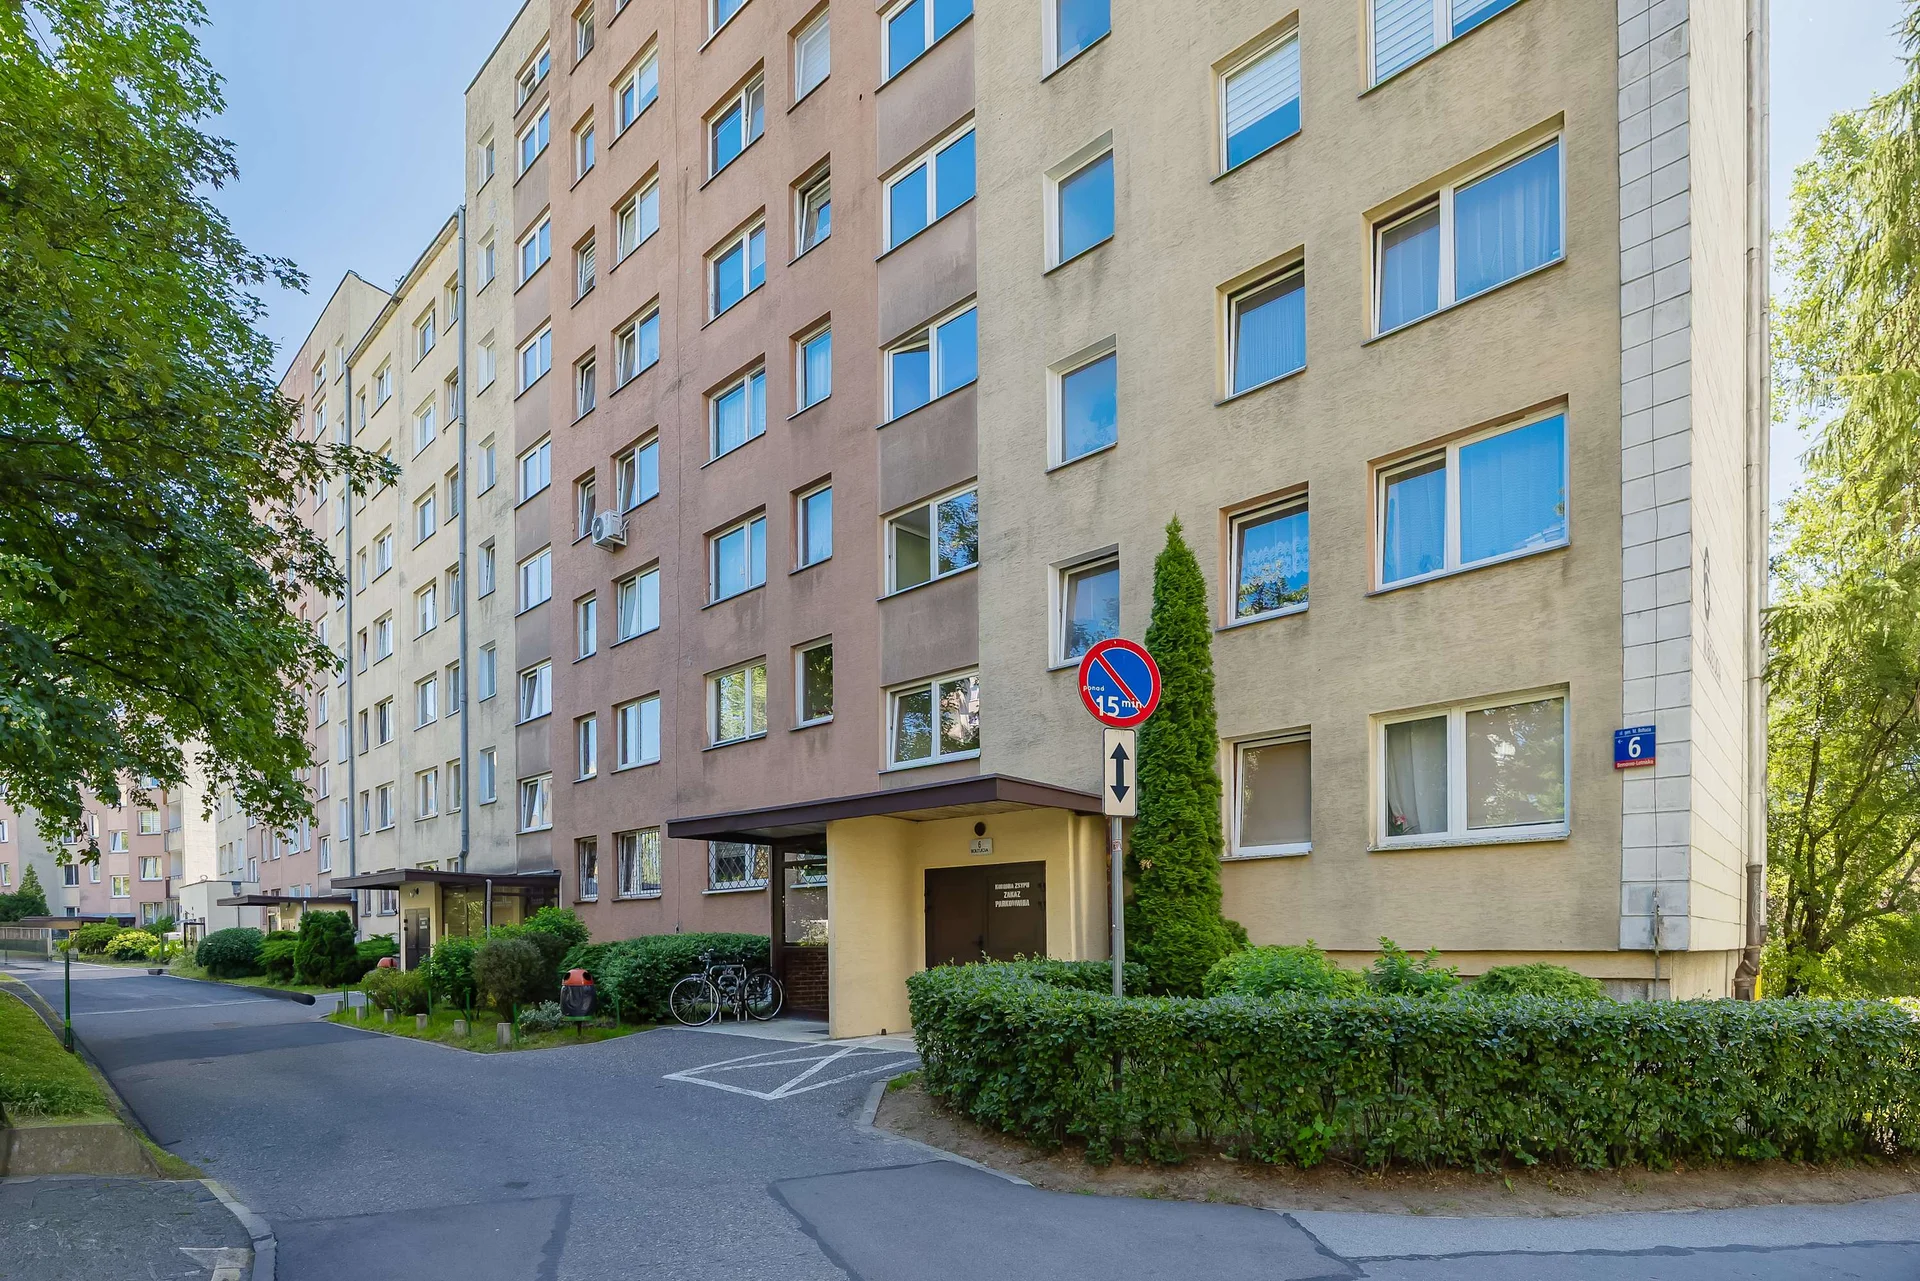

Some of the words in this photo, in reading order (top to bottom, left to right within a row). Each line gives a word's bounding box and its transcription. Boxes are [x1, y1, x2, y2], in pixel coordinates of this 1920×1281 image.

[1096, 695, 1120, 717] 15
[1121, 697, 1142, 709] min
[1628, 736, 1642, 758] 6
[977, 840, 982, 849] 6
